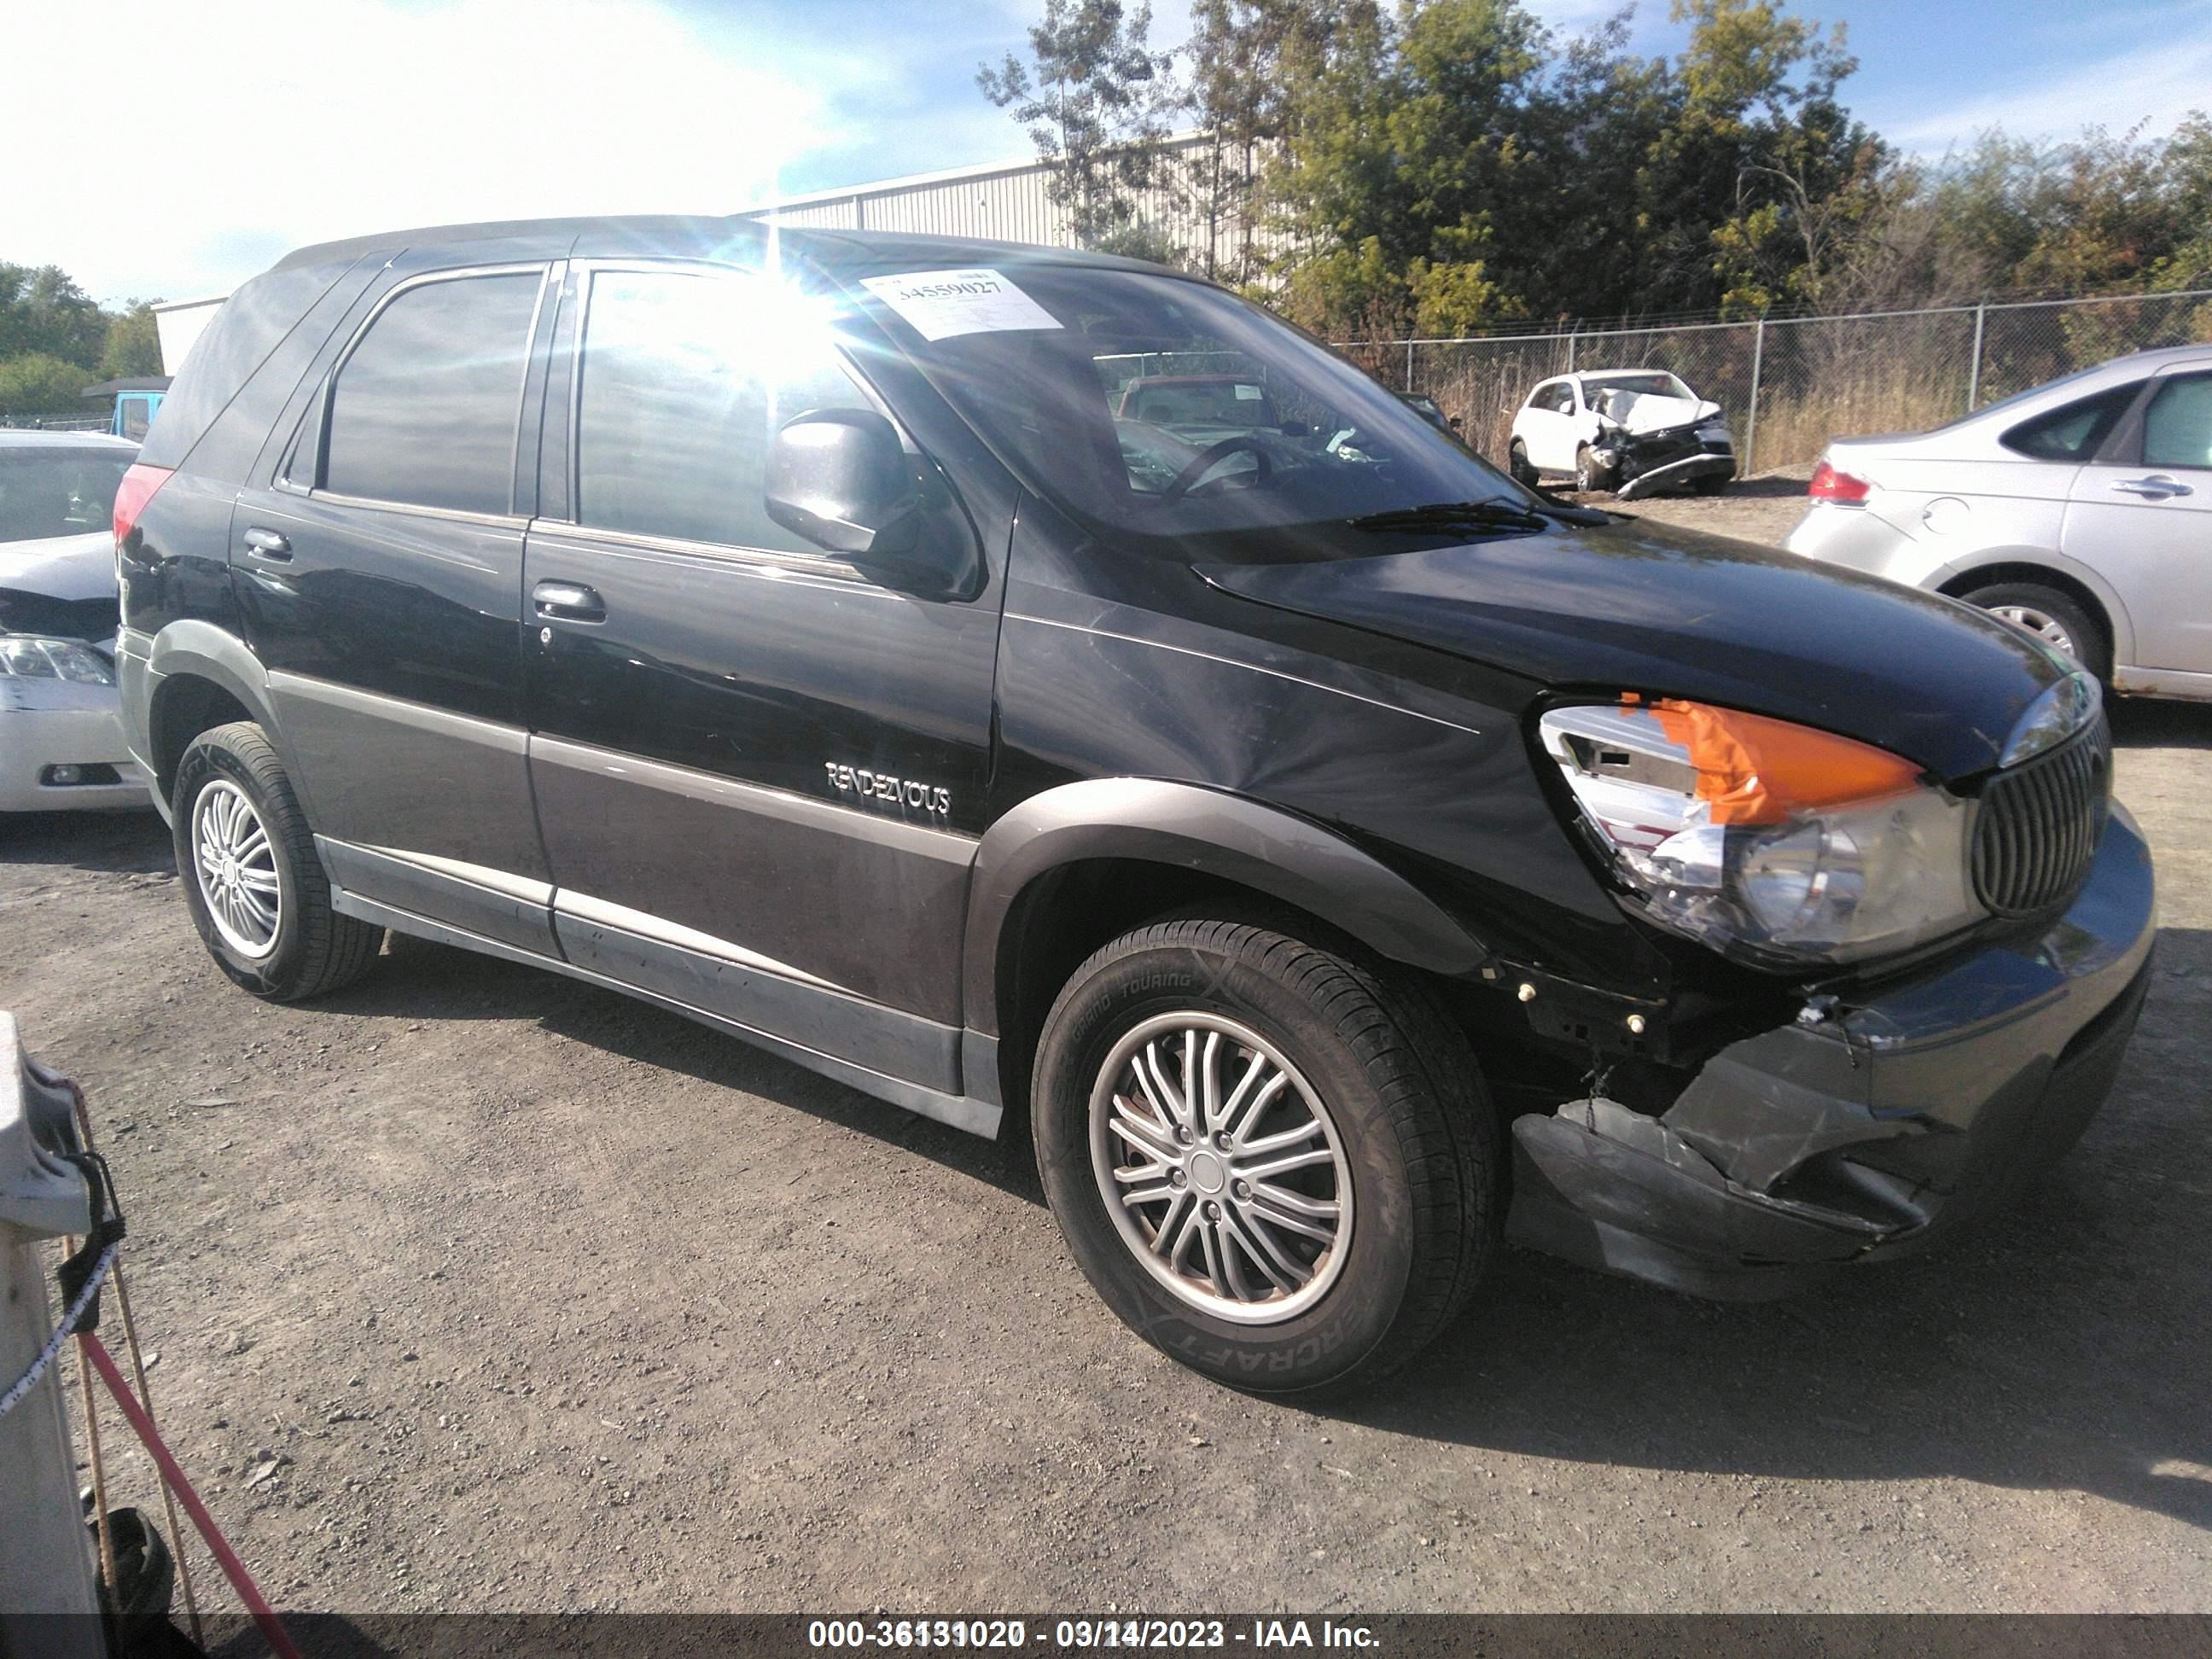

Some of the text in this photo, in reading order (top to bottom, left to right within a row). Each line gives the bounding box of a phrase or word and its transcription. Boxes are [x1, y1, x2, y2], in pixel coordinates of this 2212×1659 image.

[824, 761, 951, 815] RENDEZVOUS
[1073, 993, 1113, 1043] GRAND
[1121, 972, 1193, 998] TOURING
